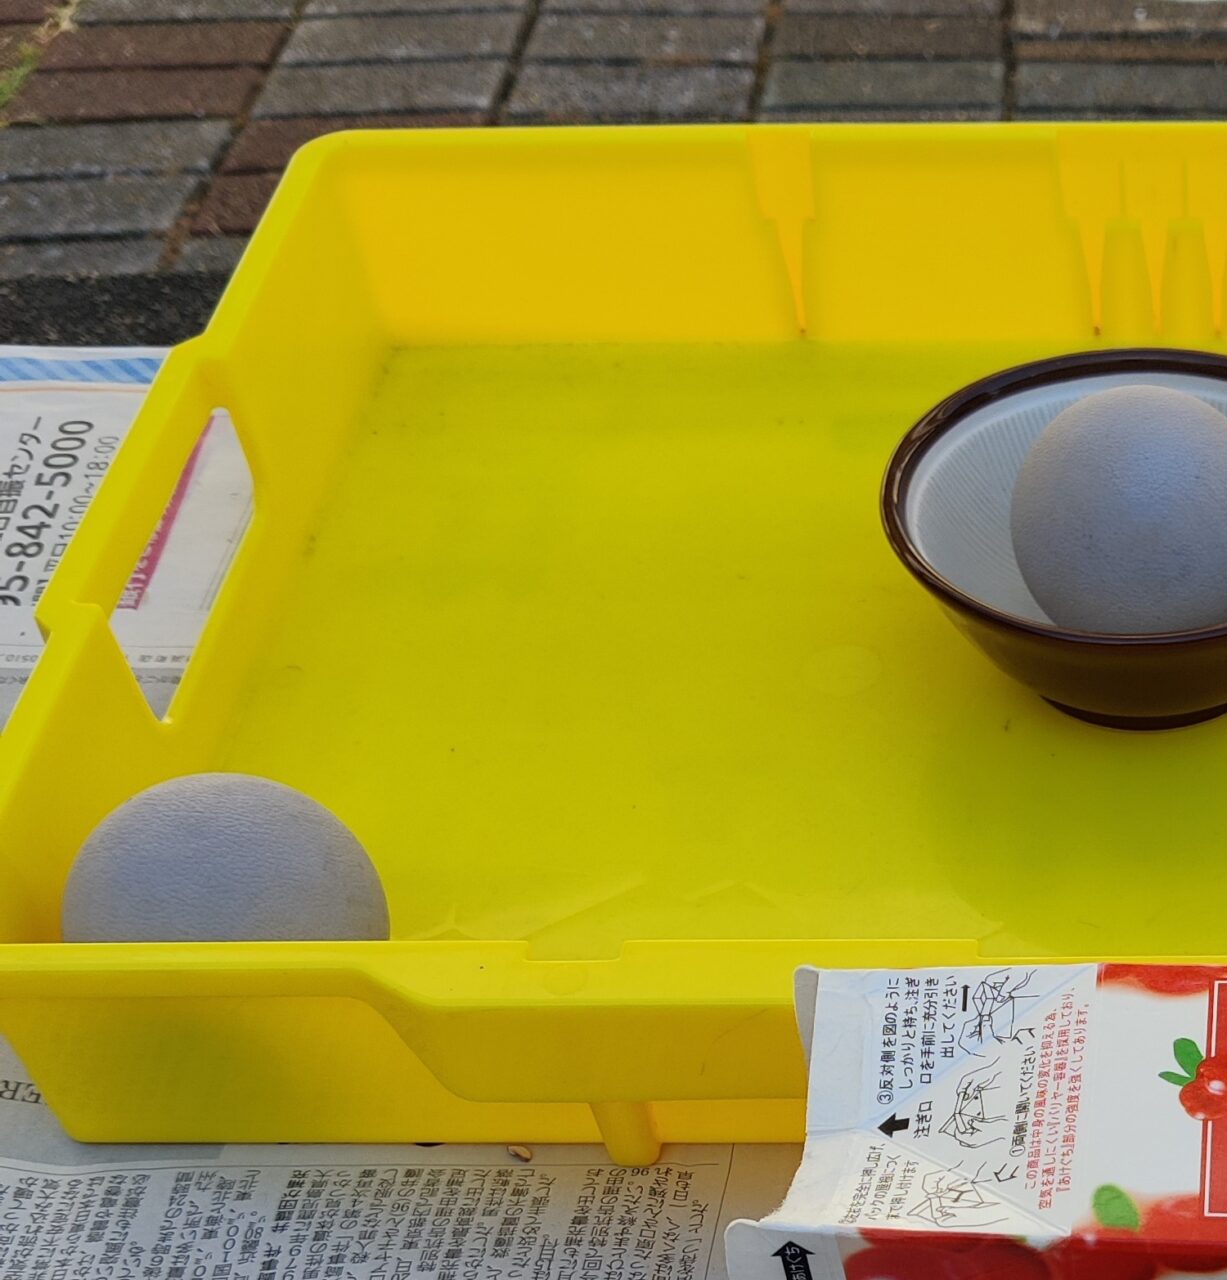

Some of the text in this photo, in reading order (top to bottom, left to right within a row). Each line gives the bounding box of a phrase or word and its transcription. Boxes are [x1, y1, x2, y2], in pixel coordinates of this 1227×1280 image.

[942, 975, 956, 1058] 出してください
[914, 1101, 932, 1139] 注ぎ口
[784, 1246, 807, 1280] あけぐち
